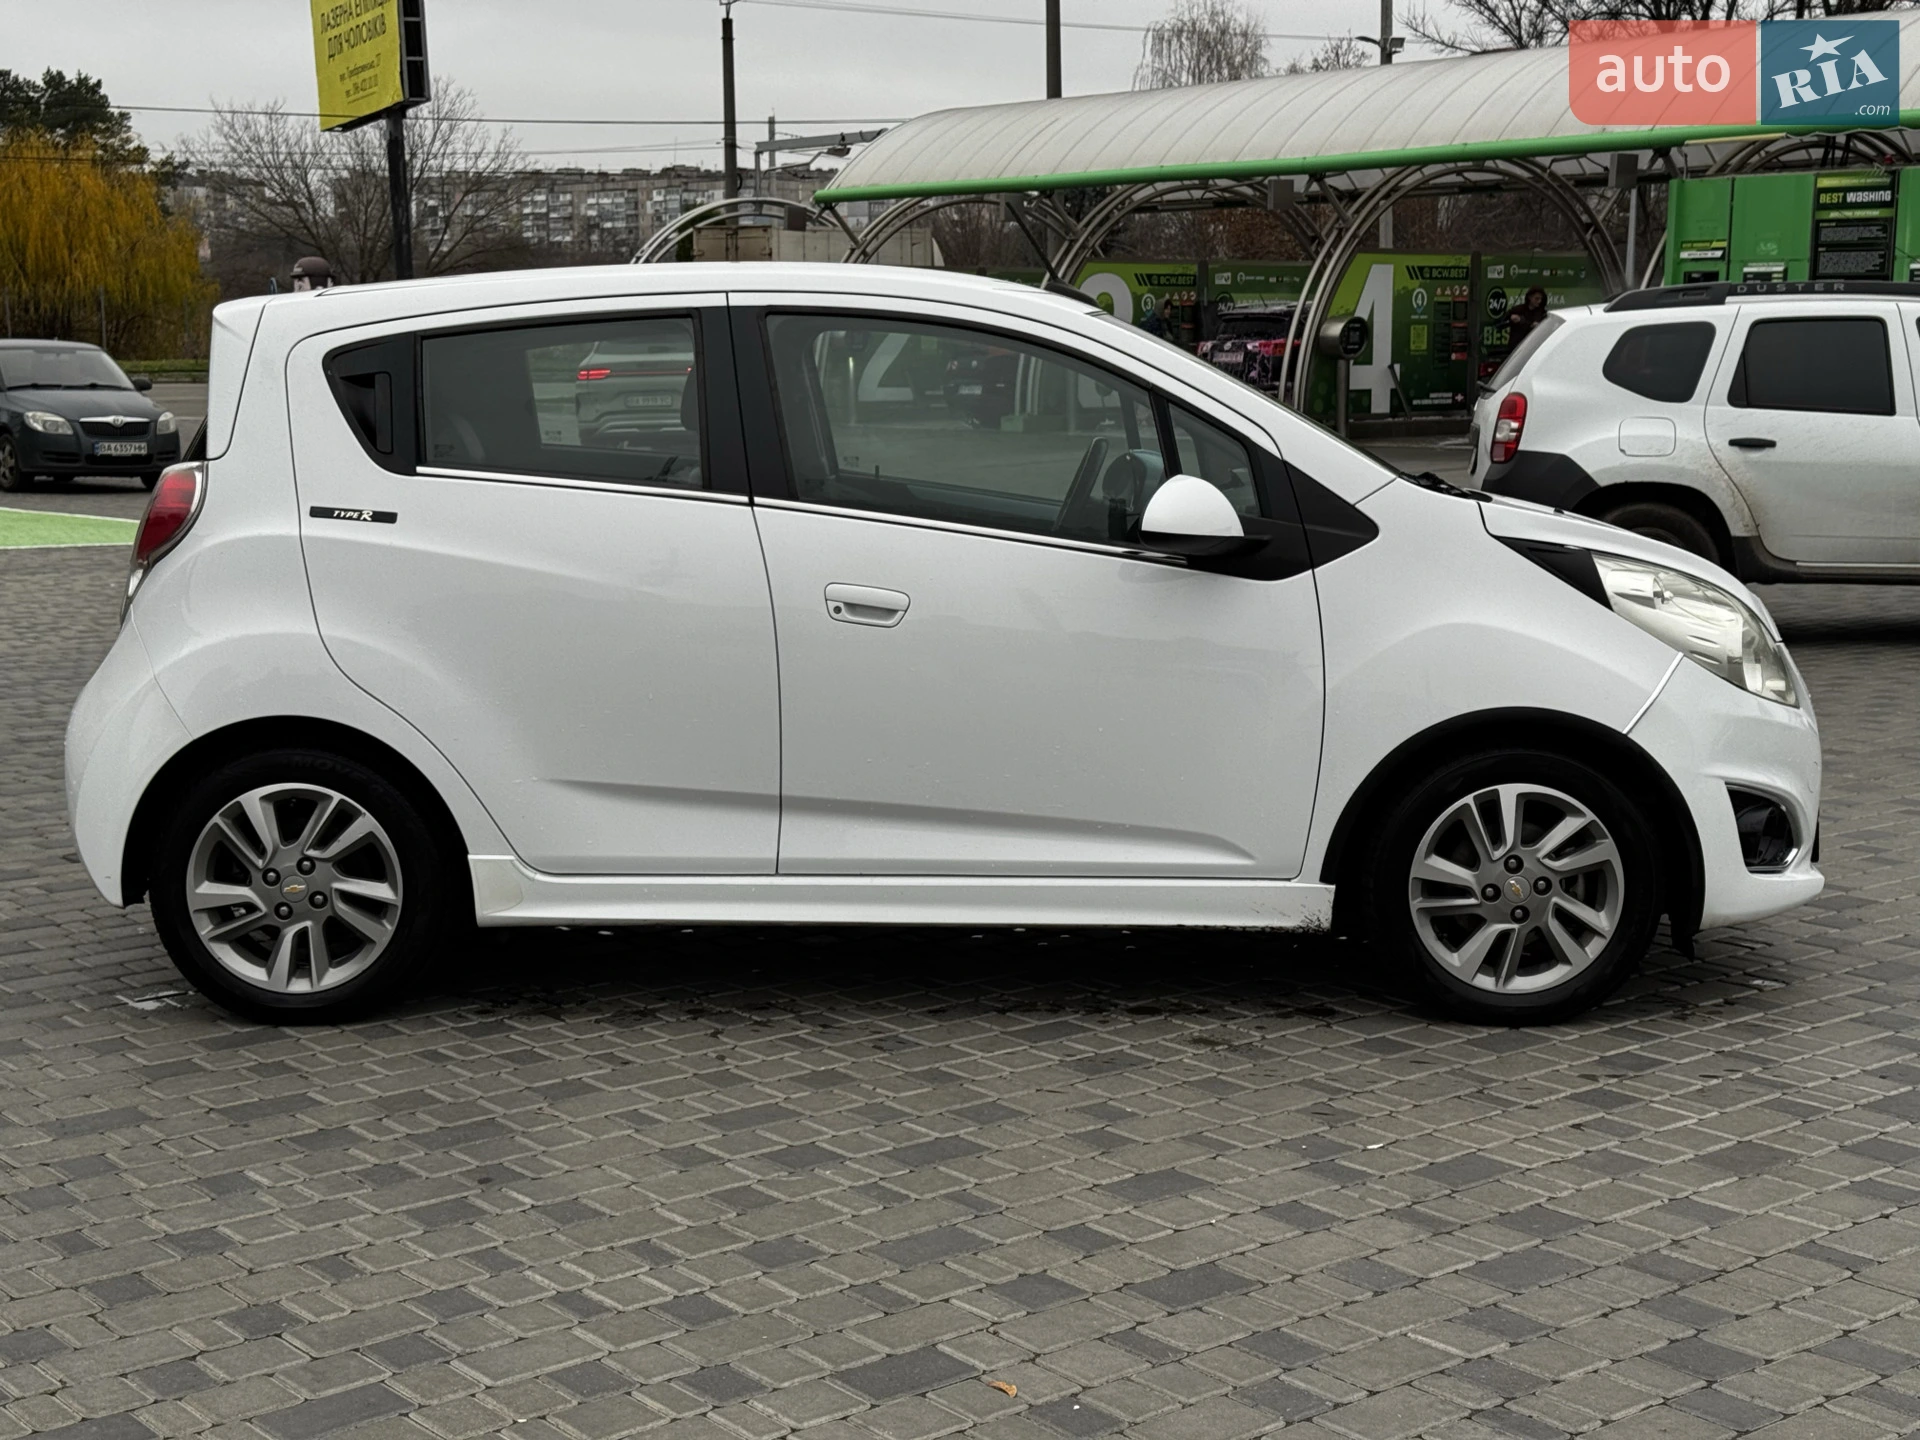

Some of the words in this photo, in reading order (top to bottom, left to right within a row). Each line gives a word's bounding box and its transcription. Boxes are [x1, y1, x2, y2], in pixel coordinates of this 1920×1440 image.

[1819, 192, 1844, 204] BEST
[1737, 283, 1845, 293] DUSTER
[1489, 298, 1506, 310] 24/7
[1483, 326, 1511, 345] BES
[333, 510, 360, 519] TYPE
[360, 510, 373, 521] R
